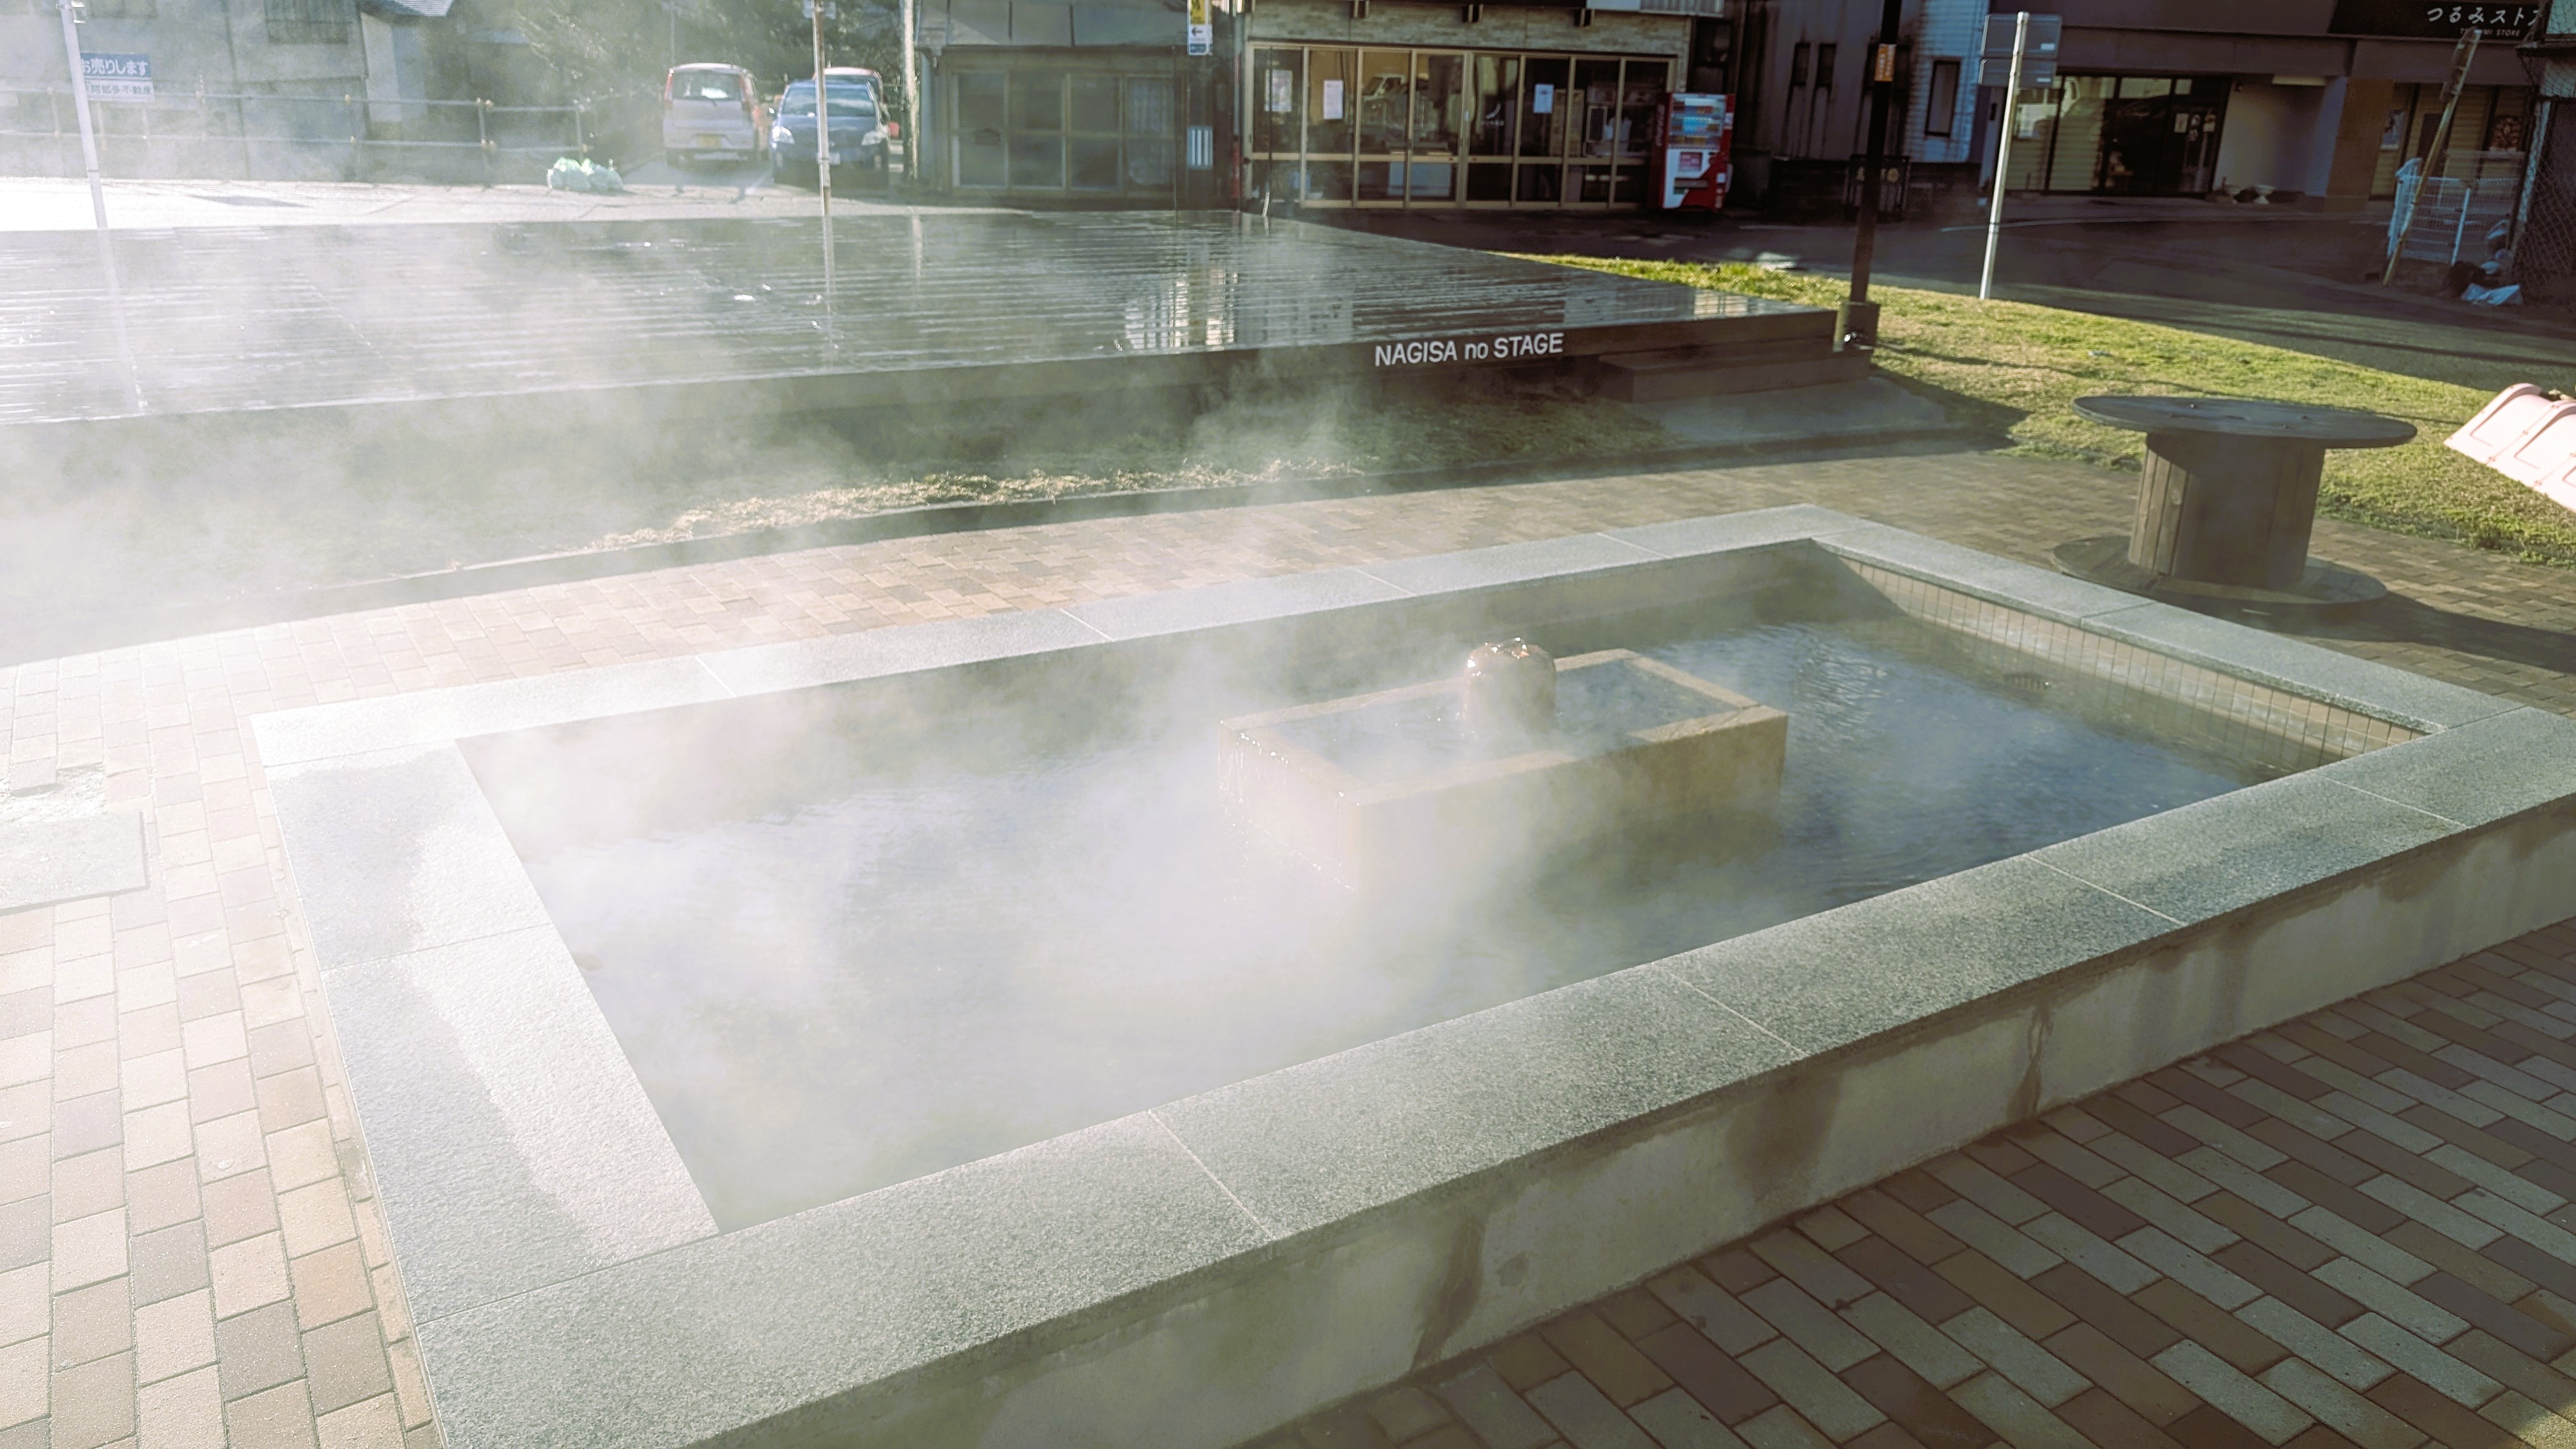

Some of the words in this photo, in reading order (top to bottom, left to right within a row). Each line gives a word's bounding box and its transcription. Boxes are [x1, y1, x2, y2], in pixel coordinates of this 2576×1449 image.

[82, 57, 148, 75] お売りします
[1375, 341, 1458, 367] NAGISA
[1464, 342, 1489, 360] no
[1493, 332, 1565, 358] STAGE
